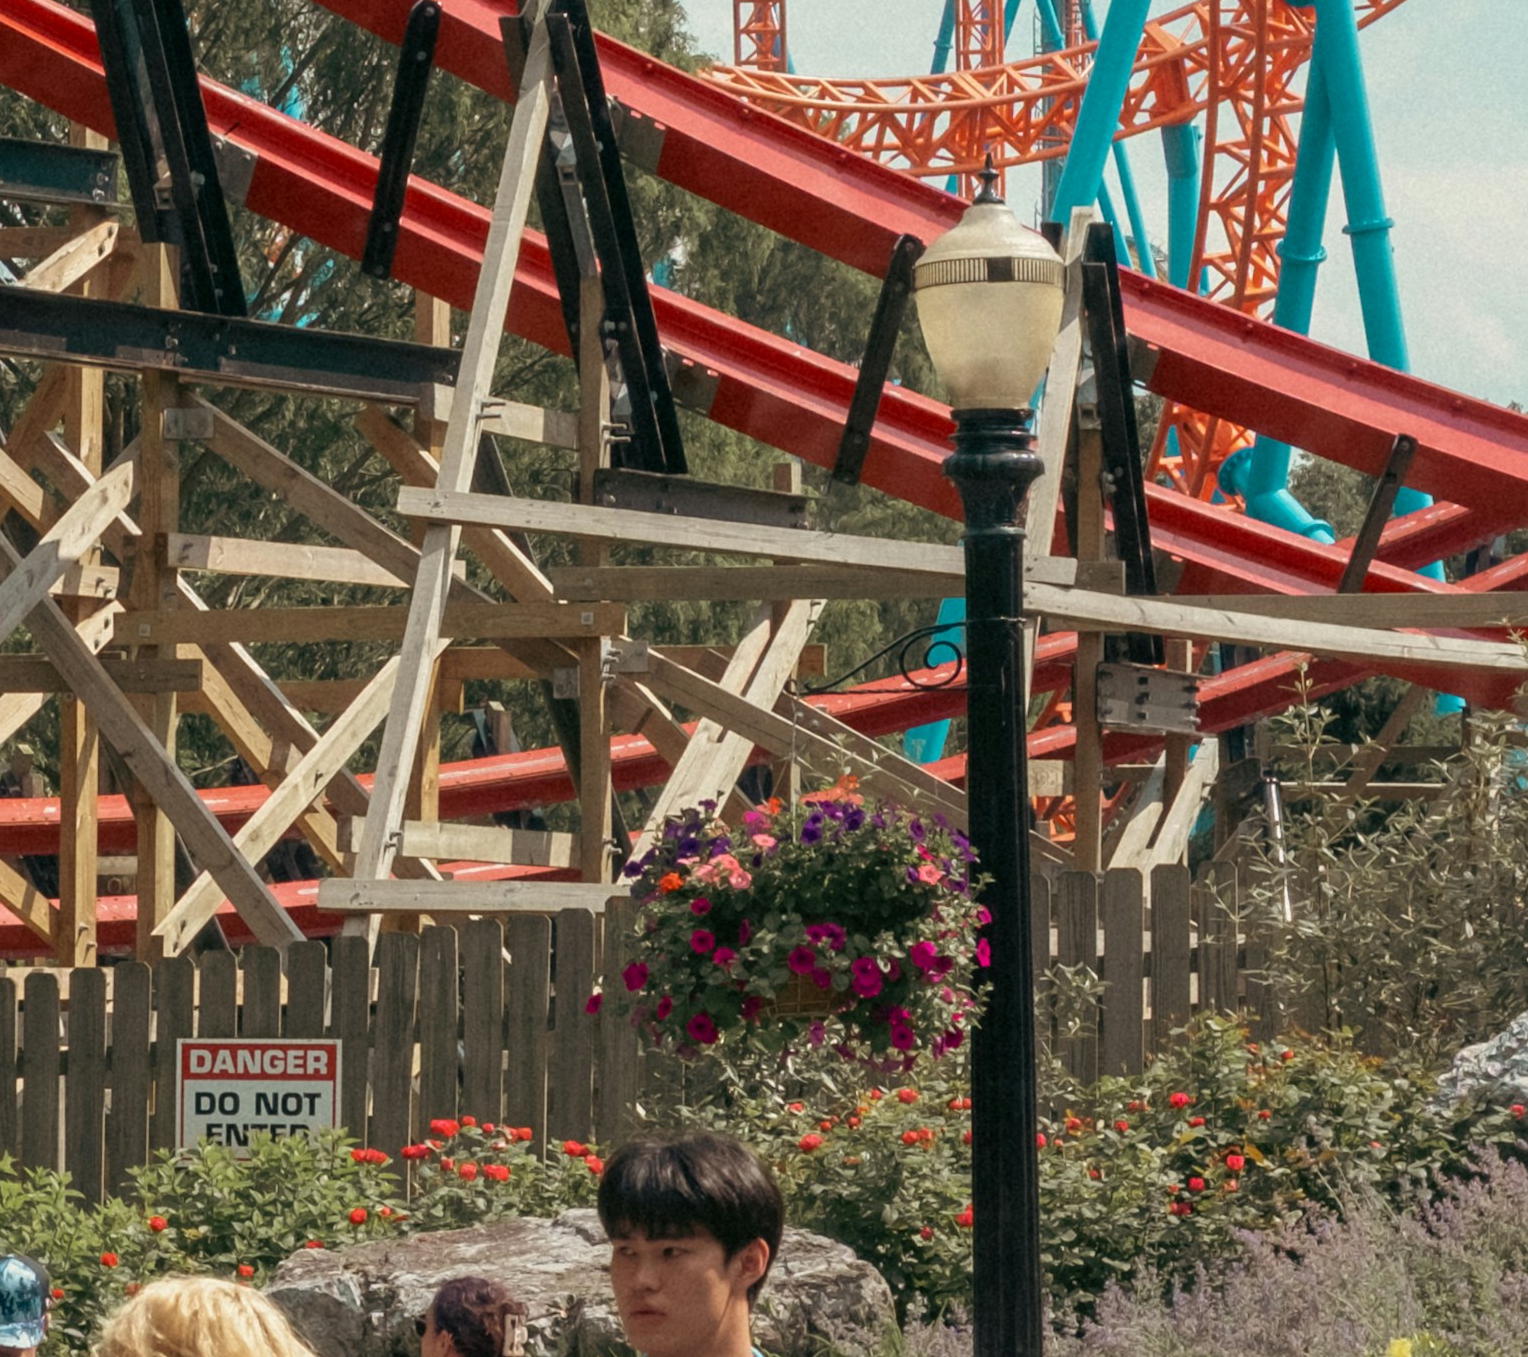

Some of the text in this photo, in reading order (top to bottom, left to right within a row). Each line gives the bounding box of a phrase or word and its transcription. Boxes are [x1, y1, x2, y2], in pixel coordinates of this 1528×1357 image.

[189, 1049, 328, 1074] DANGER
[195, 1092, 321, 1116] DO NOT
